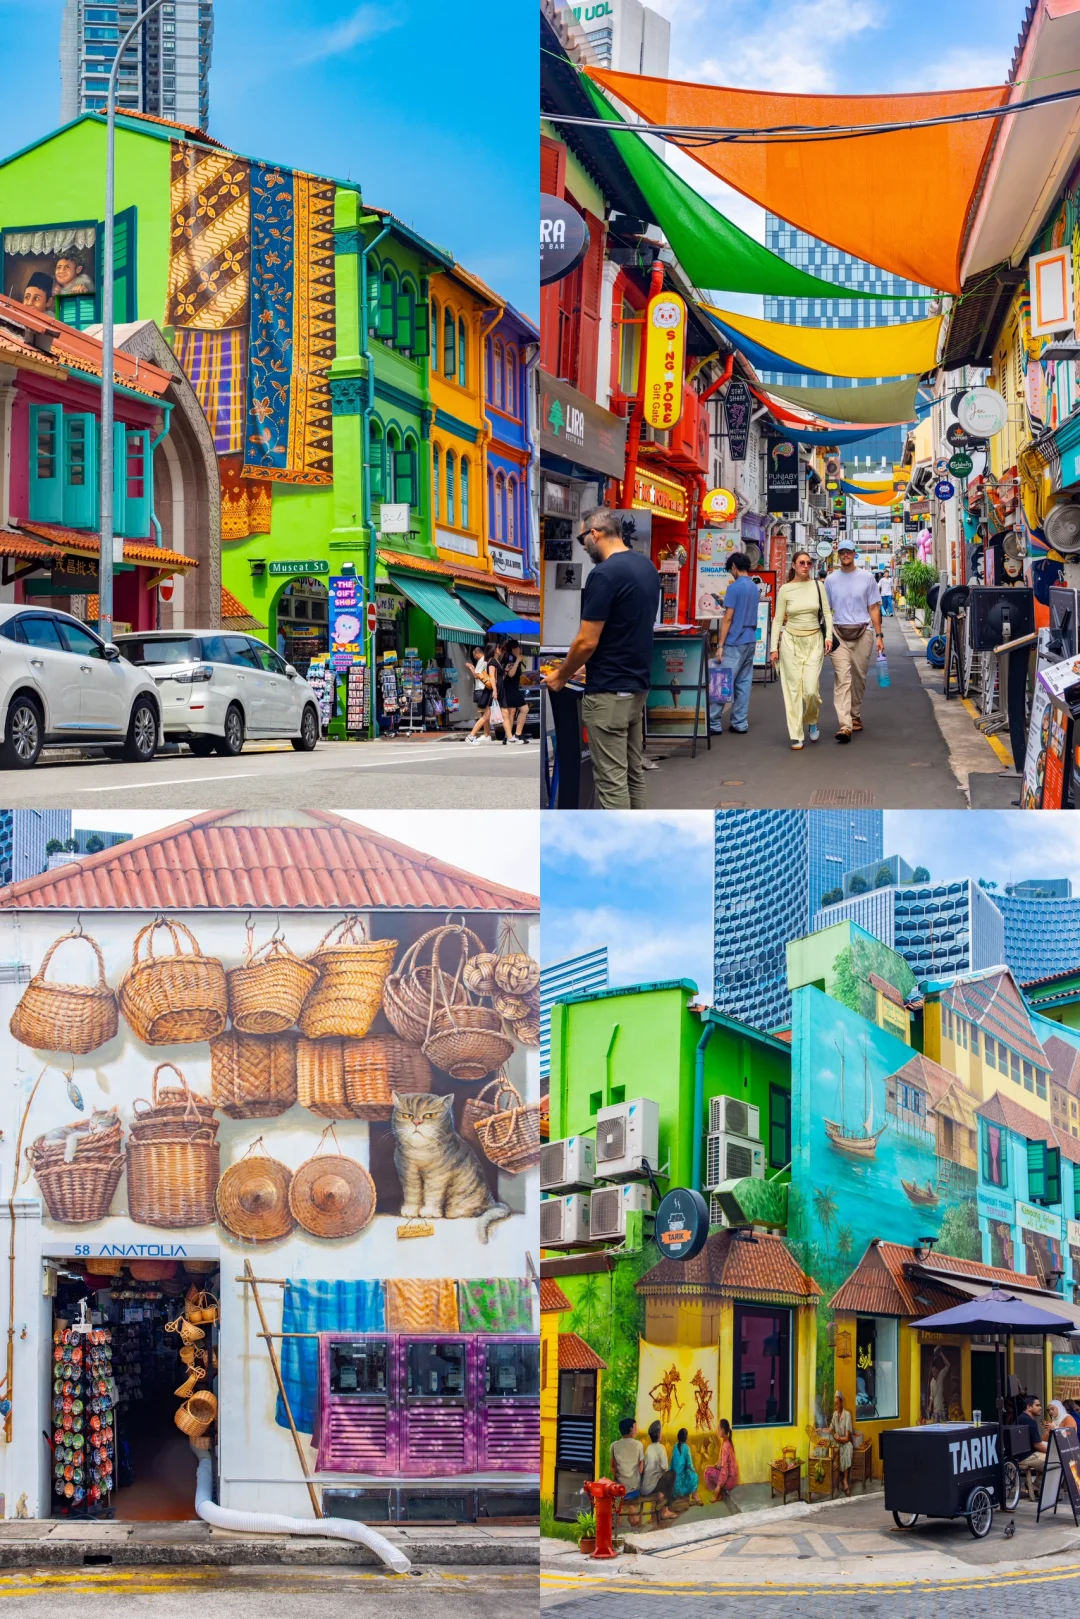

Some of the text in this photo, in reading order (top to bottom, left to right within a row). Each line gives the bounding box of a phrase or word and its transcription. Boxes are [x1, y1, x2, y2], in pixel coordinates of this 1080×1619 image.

[585, 1, 613, 21] UOL
[651, 383, 661, 424] Gift Gate
[565, 404, 585, 439] LIRA
[949, 461, 972, 469] Carlsberg
[272, 562, 324, 572] Muscat St
[336, 580, 354, 589] THE
[336, 589, 355, 598] GIFT
[334, 598, 357, 607] SHOP
[386, 599, 395, 610] SG
[332, 643, 360, 652] I SG
[668, 1233, 684, 1241] TARIK
[74, 1244, 187, 1256] 58 ANATOLIA
[948, 1434, 999, 1475] TARIK
